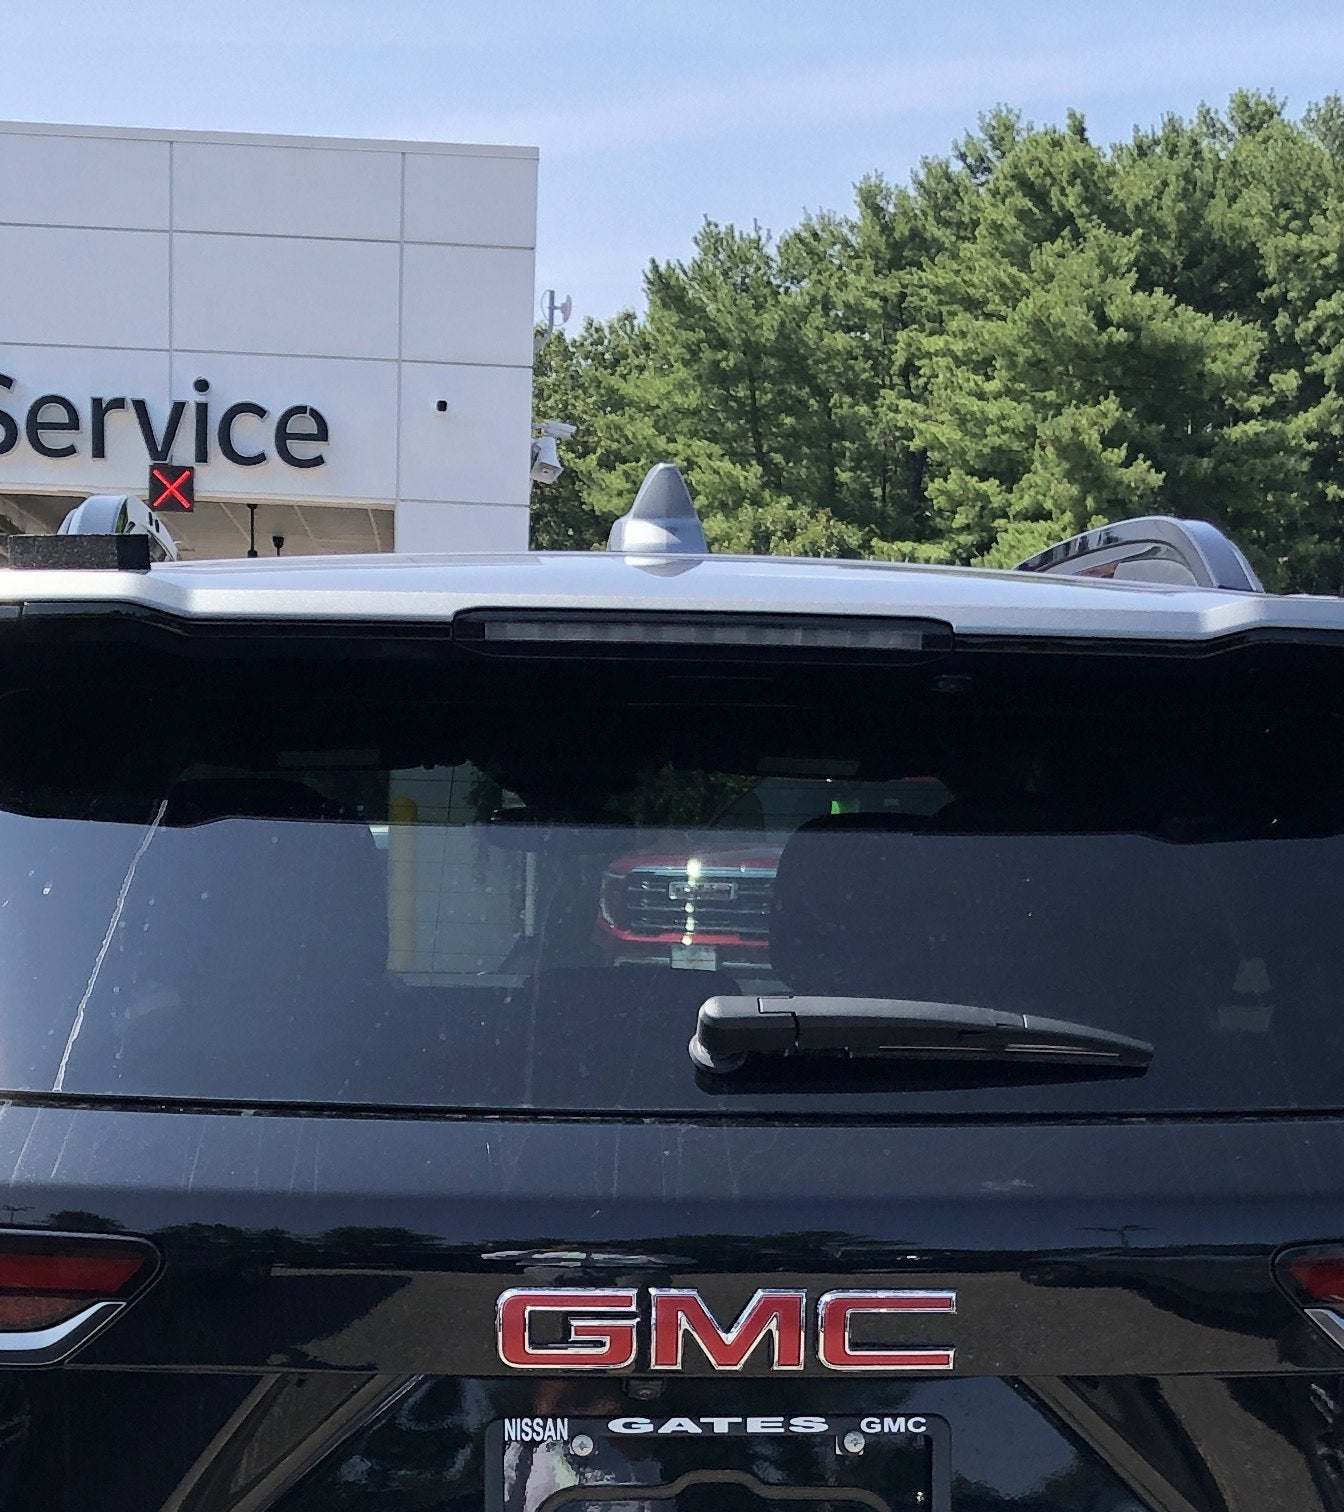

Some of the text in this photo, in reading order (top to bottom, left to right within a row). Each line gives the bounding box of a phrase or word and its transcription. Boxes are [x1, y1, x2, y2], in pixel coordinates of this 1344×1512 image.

[496, 1287, 957, 1370] GMC
[503, 1416, 928, 1442] NISSAN GATES GMC
